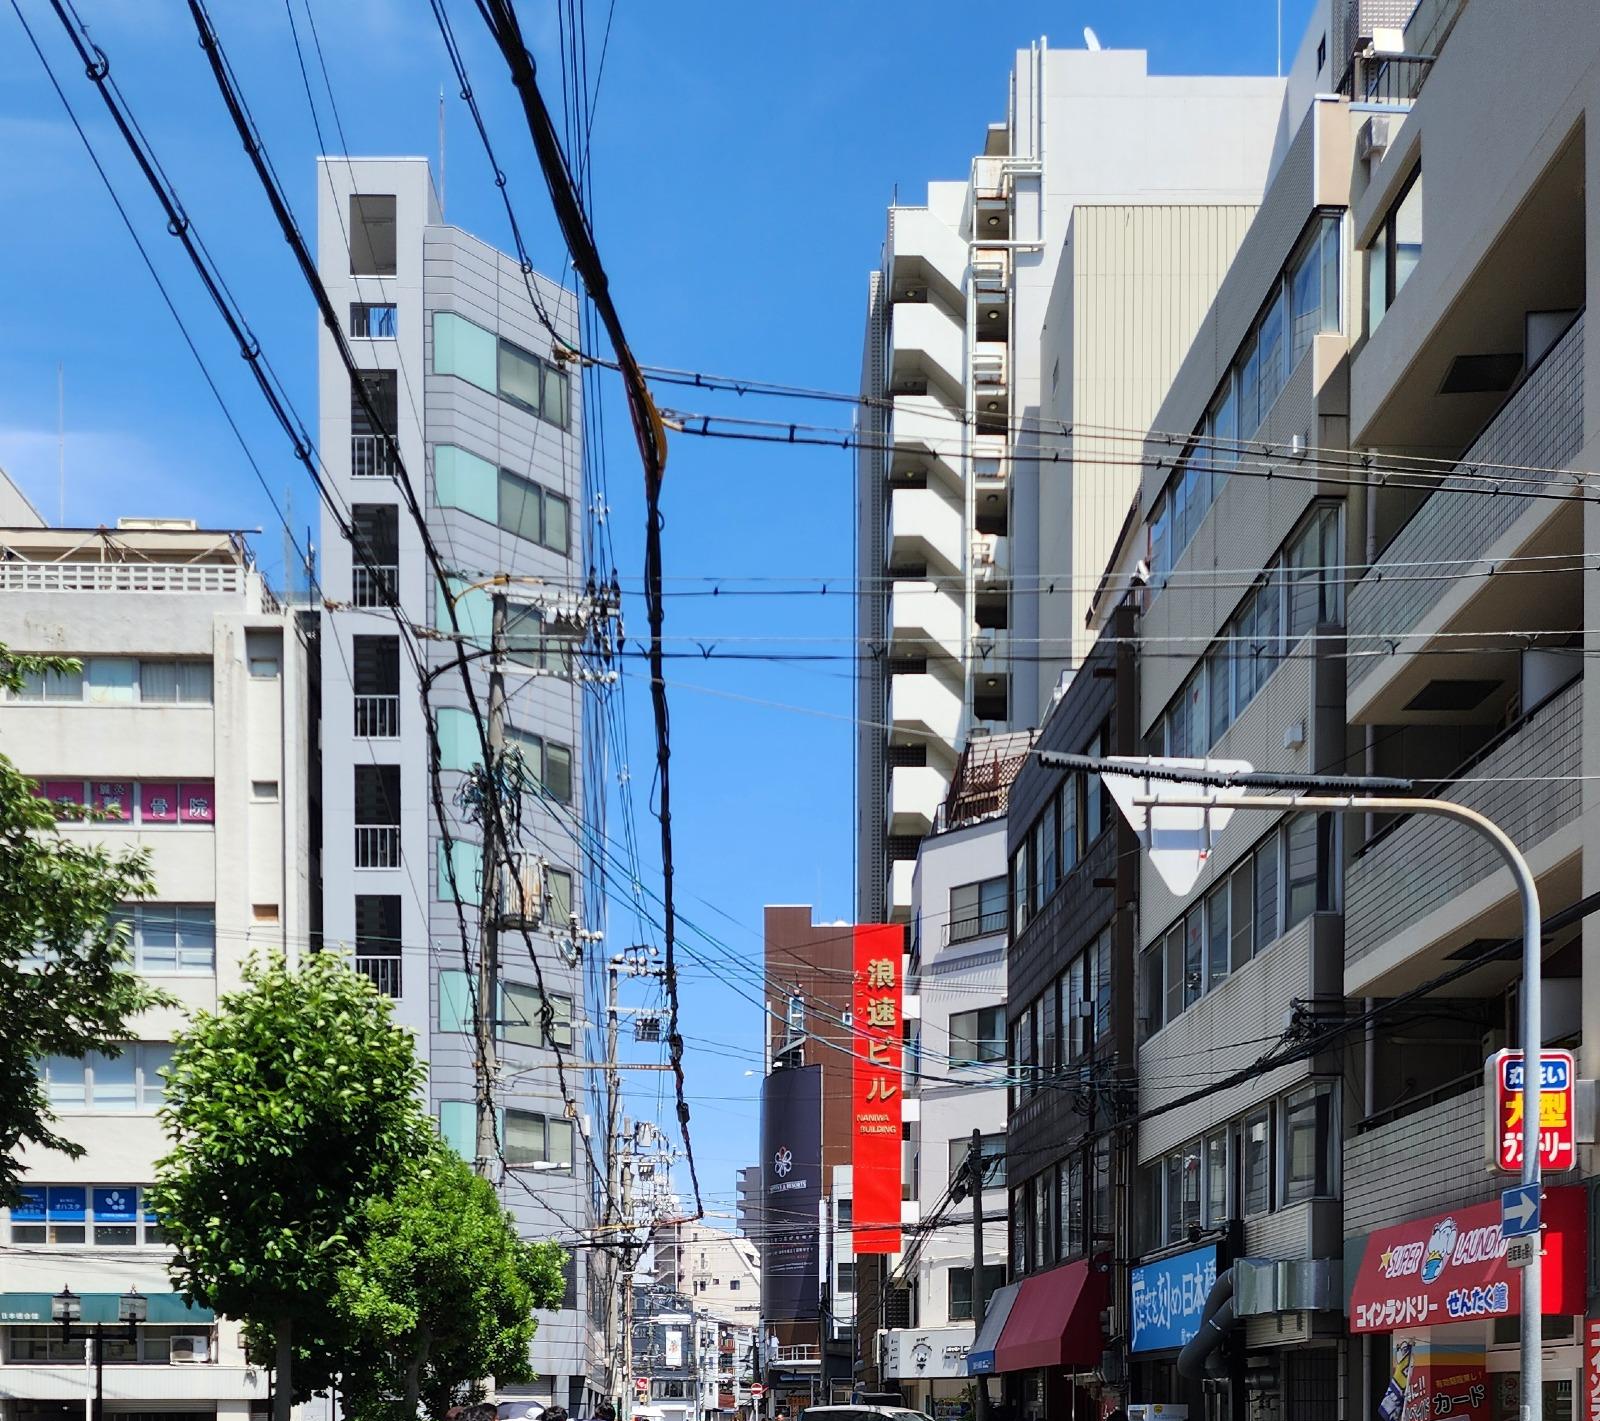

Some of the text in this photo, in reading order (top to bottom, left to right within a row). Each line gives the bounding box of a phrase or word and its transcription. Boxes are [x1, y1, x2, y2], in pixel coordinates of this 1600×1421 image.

[867, 958, 897, 1100] 浪速ビル
[1385, 1224, 1511, 1279] SUPER LAUNDR
[1356, 1281, 1508, 1328] コインランドリー せんたく館
[1432, 1384, 1485, 1415] カード
